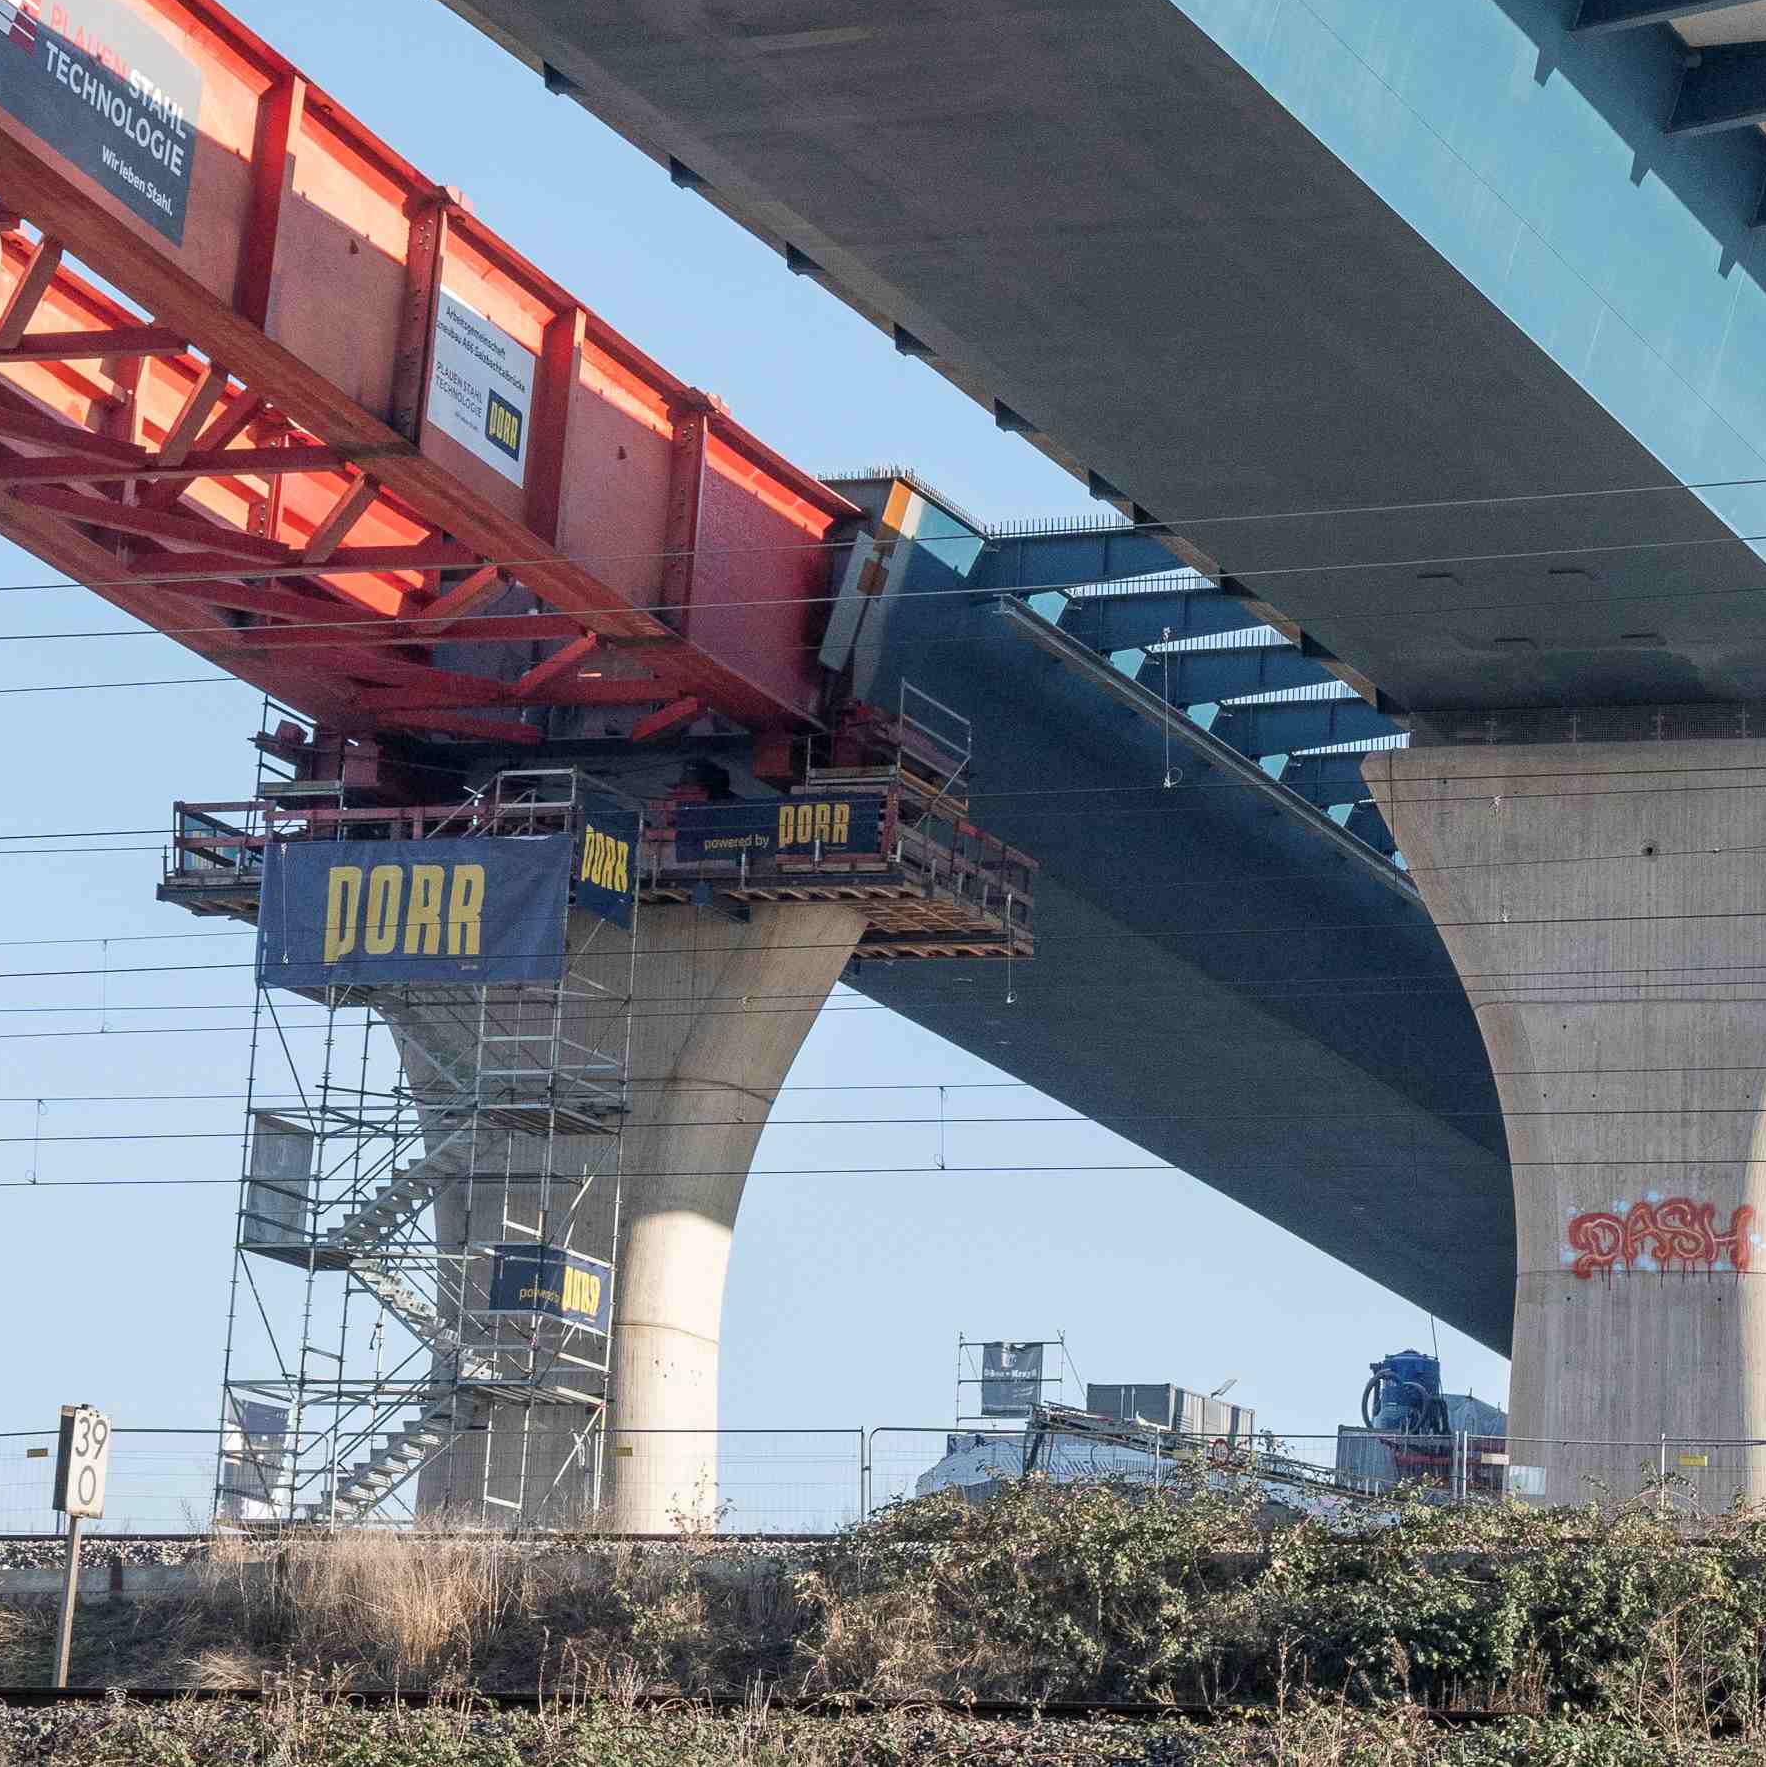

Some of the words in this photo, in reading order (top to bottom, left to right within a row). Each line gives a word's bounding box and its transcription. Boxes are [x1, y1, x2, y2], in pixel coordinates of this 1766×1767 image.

[46, 41, 185, 177] TECHNOLOGIE
[102, 144, 120, 171] Wir
[119, 160, 146, 193] leben
[704, 834, 752, 851] powered
[755, 833, 770, 849] by
[75, 1416, 108, 1460] 39
[79, 1465, 97, 1505] 0
